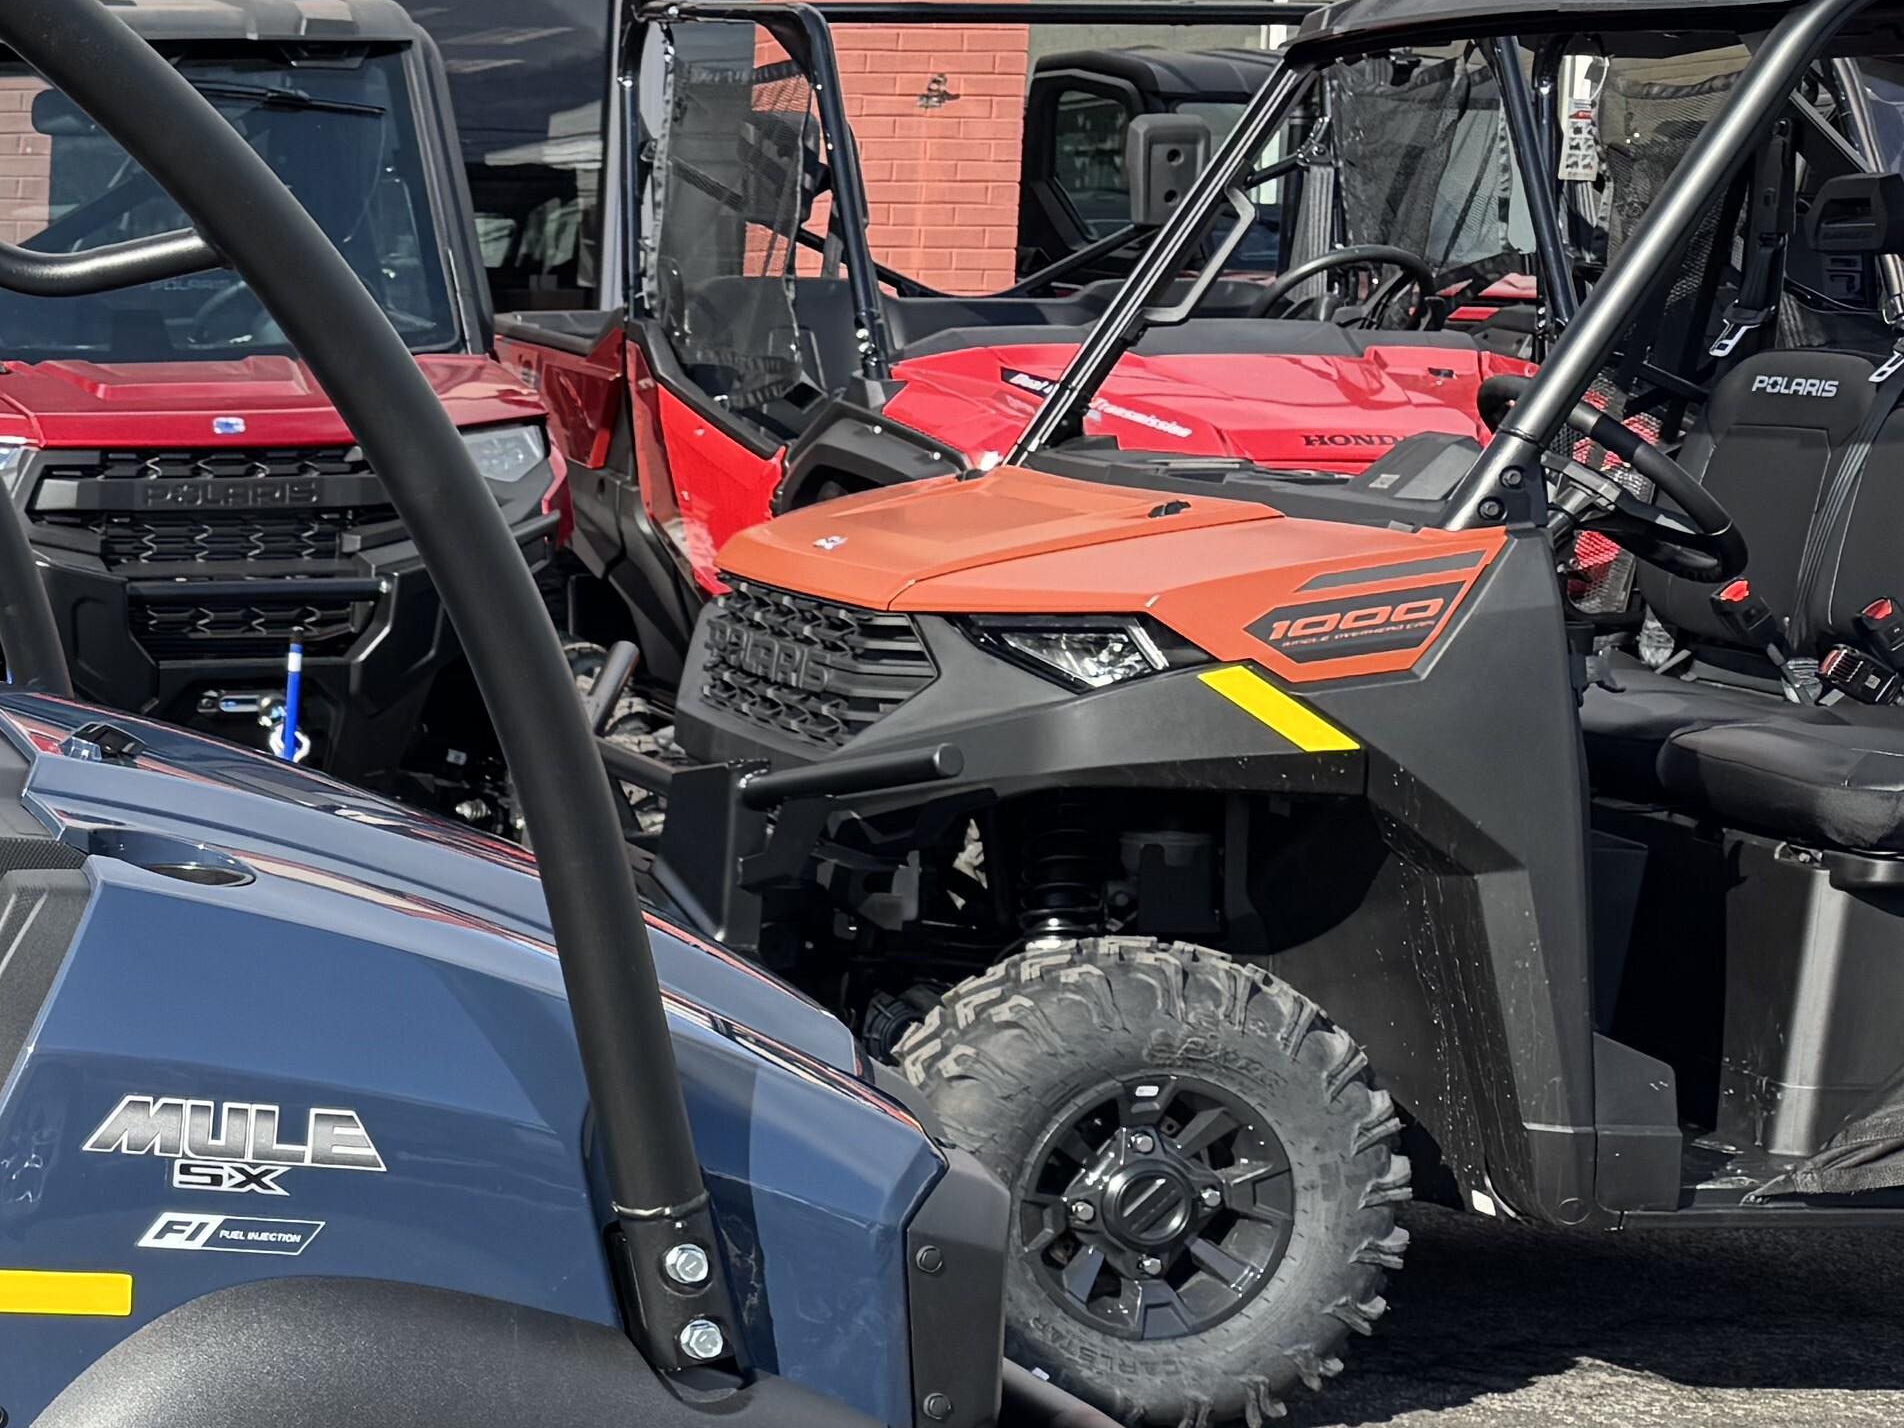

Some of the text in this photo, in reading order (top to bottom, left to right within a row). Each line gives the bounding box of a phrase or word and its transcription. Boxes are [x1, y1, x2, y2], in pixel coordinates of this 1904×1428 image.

[1751, 375, 1839, 398] POLARIS
[1301, 434, 1405, 446] HOND
[148, 483, 318, 507] POLARIS
[1268, 598, 1444, 640] 1000
[82, 1095, 387, 1171] MULE
[174, 1159, 292, 1196] SX
[154, 1221, 301, 1243] FI FUEL INJECTION
